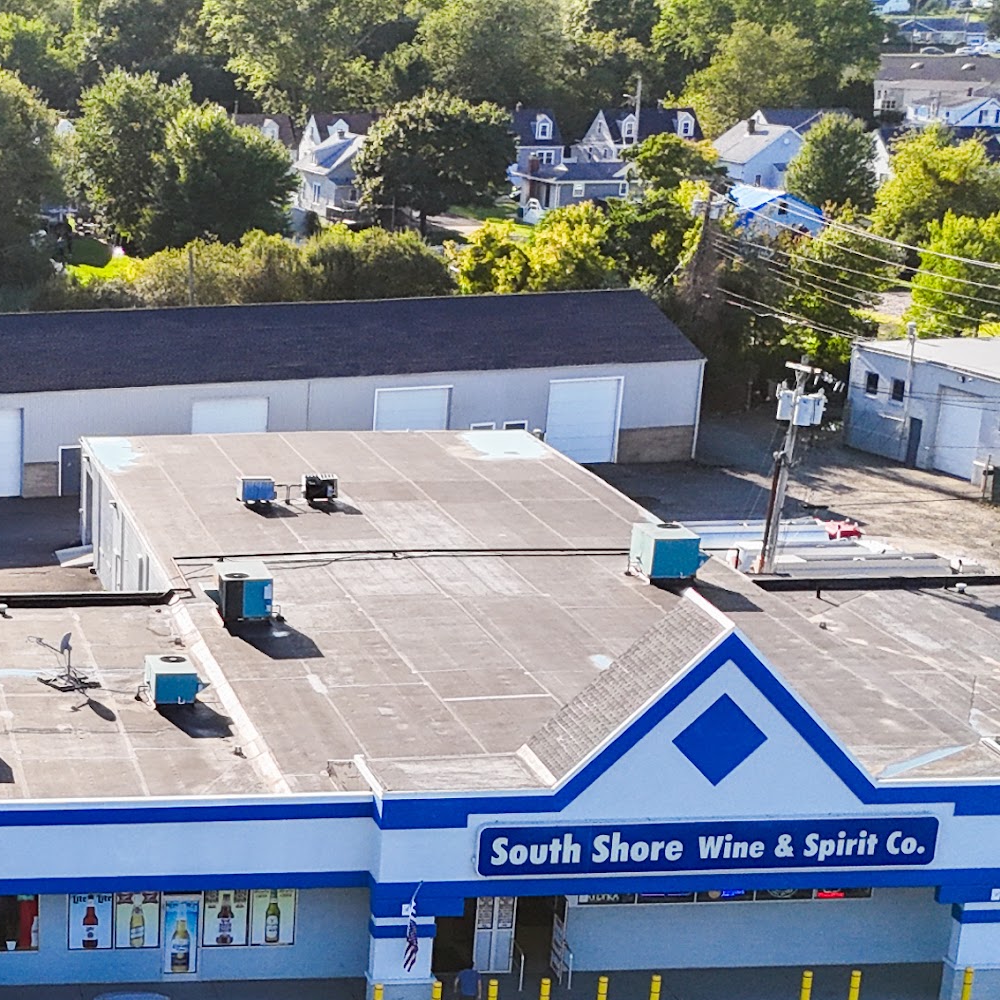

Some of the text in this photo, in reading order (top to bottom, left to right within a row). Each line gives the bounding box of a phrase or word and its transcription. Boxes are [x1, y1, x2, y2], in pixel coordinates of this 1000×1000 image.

[490, 830, 926, 866] South Shore Wine & Spirit Co.
